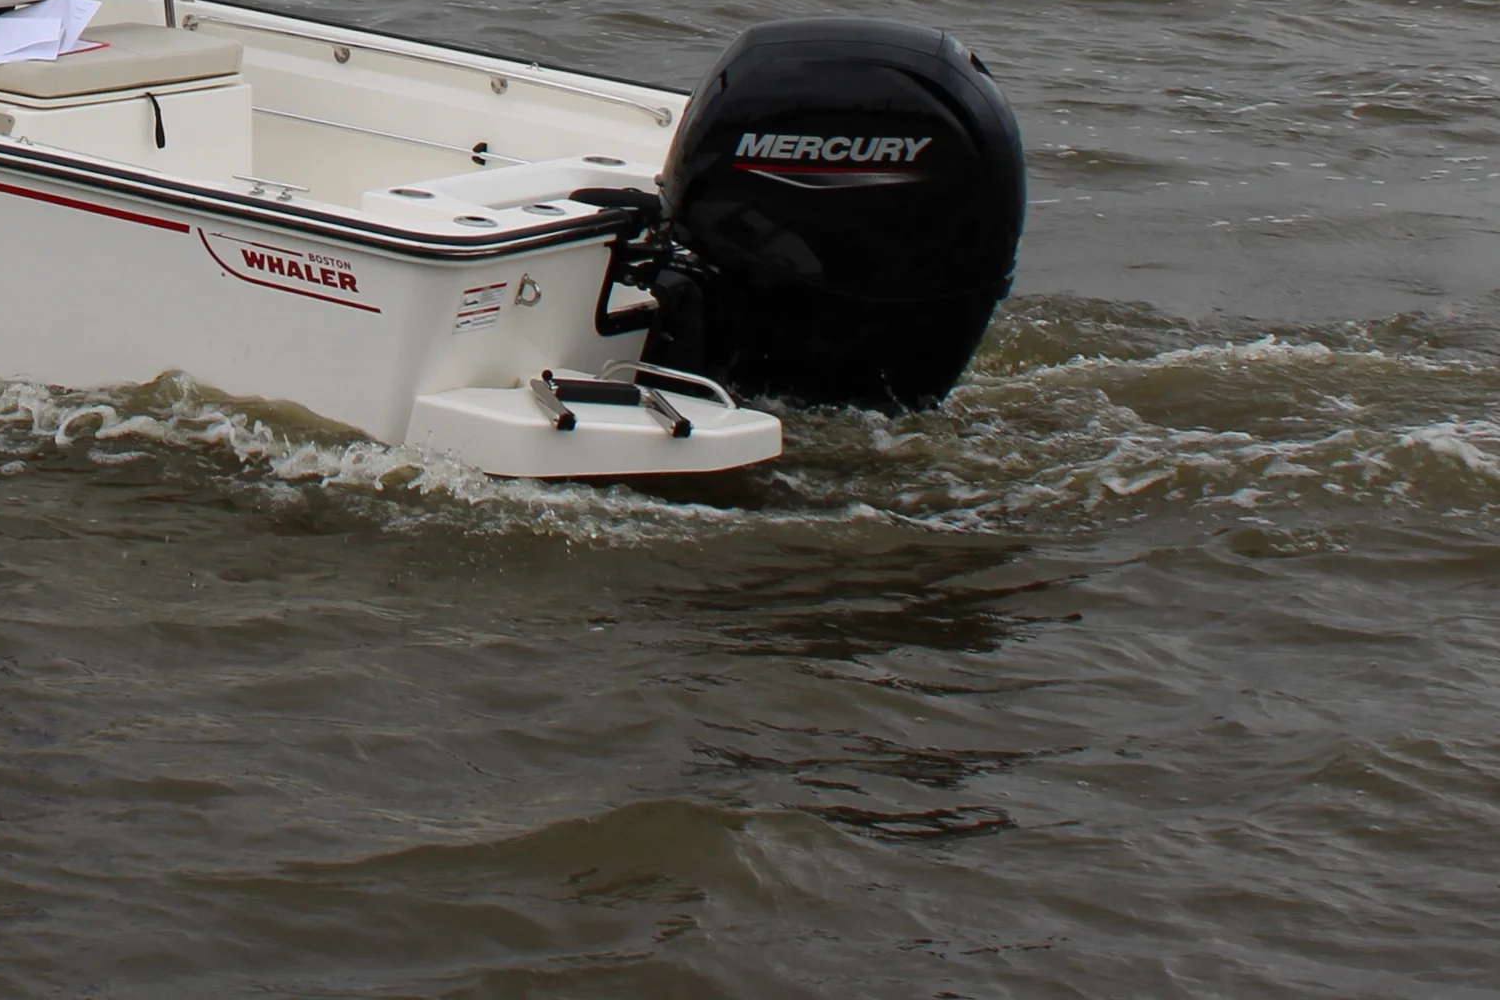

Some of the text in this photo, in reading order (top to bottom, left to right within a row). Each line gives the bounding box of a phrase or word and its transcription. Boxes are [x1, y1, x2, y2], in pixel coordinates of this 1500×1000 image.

[735, 133, 932, 162] MERCURY
[241, 249, 359, 292] WHALER
[308, 253, 352, 270] BOSTON
